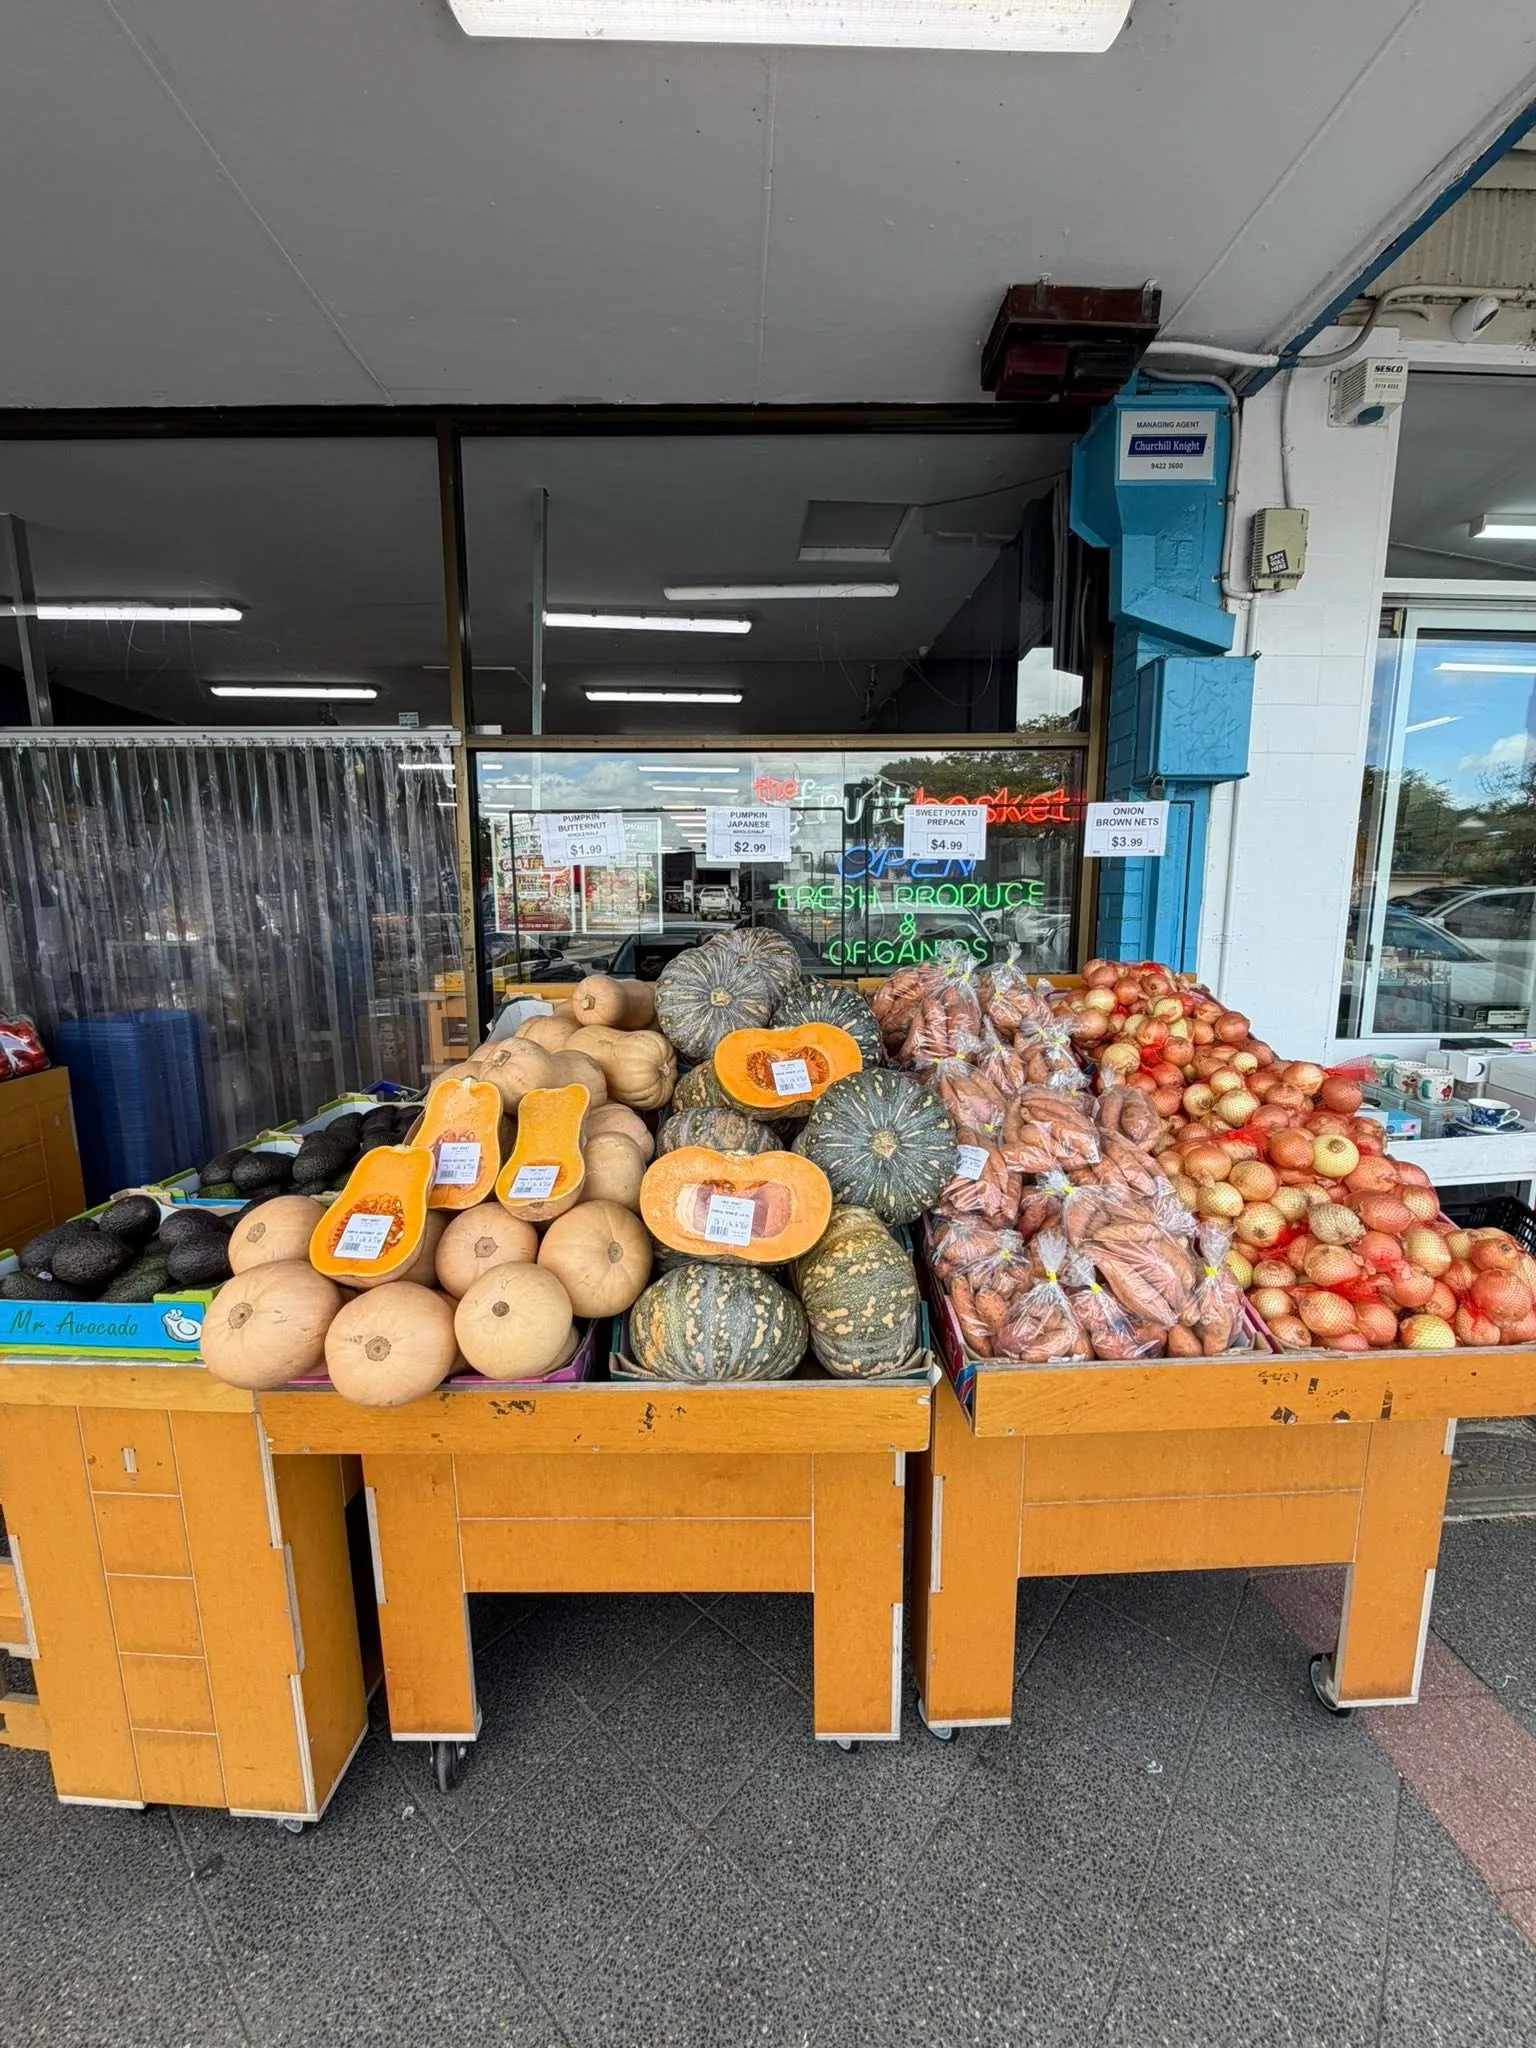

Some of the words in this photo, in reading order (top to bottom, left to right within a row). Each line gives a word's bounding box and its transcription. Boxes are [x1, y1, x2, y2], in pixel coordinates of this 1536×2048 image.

[1374, 365, 1403, 373] SESCO
[1134, 440, 1172, 451] Churchill
[1173, 440, 1200, 453] Knight
[752, 775, 799, 801] the
[730, 811, 768, 819] PUMPKIN
[915, 809, 943, 817] SWEET
[945, 809, 978, 817] POTATO
[1113, 807, 1145, 816] ONION
[562, 813, 600, 823] PUMPKIN
[1096, 818, 1132, 827] BROWN
[1134, 817, 1159, 826] NETS
[558, 822, 607, 833] BUTTERNUT
[734, 841, 766, 854] $2.99
[931, 838, 962, 851] $4.99
[1111, 836, 1143, 848] $3.99
[570, 844, 602, 856] $1.99
[777, 884, 877, 910] FRESH
[895, 882, 1046, 909] PRODUCE
[899, 912, 916, 936] &
[9, 1307, 50, 1336] Mr.
[56, 1309, 139, 1337] Avocado
